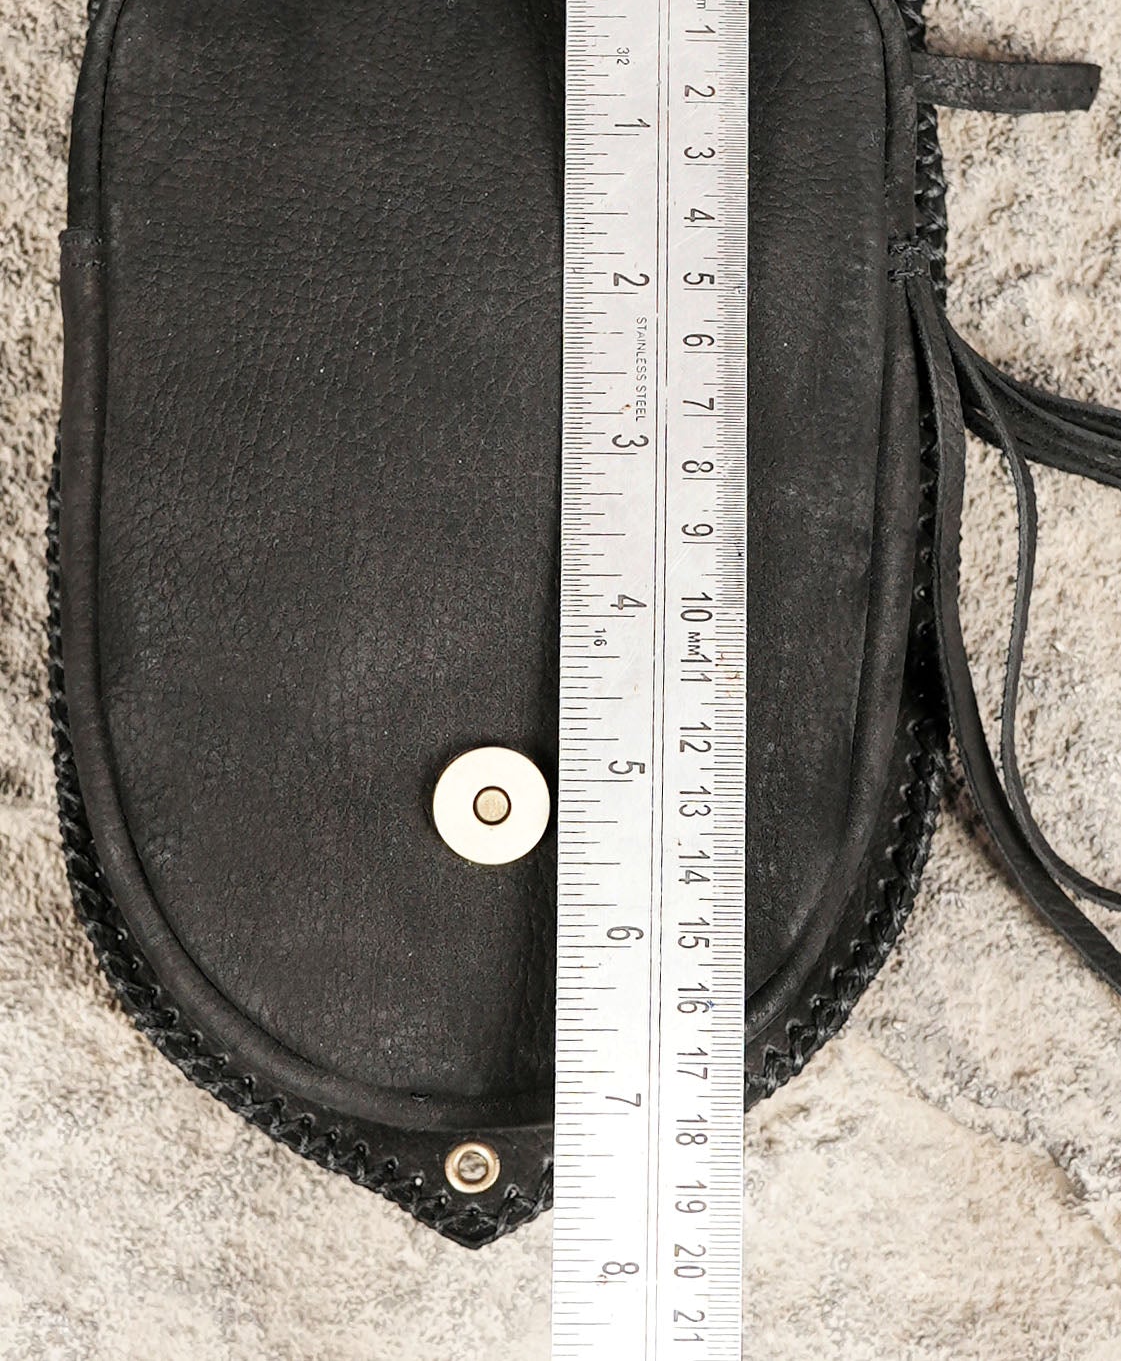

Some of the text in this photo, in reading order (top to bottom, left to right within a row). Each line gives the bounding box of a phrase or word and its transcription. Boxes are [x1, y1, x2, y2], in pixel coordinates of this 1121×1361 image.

[685, 25, 716, 33] 1
[616, 47, 630, 66] 32
[684, 85, 716, 97] 2
[684, 146, 716, 159] 3
[683, 208, 715, 222] 4
[683, 272, 715, 285] 5
[682, 333, 715, 347] 6
[635, 317, 648, 422] STAINLESS STEEL
[682, 397, 715, 411] 7
[681, 460, 714, 473] 8
[681, 523, 713, 537] 9
[680, 592, 713, 622] 10
[594, 628, 607, 647] 16
[680, 654, 712, 682] 11
[602, 118, 651, 1275] 1 2 3 4 5 6 7 8
[679, 721, 712, 753] 12
[679, 785, 711, 817] 13
[678, 850, 711, 885] 14
[677, 917, 710, 949] 15
[677, 982, 710, 1013] 16
[676, 1046, 708, 1079] 17
[675, 1114, 708, 1145] 18
[675, 1180, 707, 1213] 19
[674, 1243, 706, 1278] 20
[673, 1309, 705, 1342] 21
